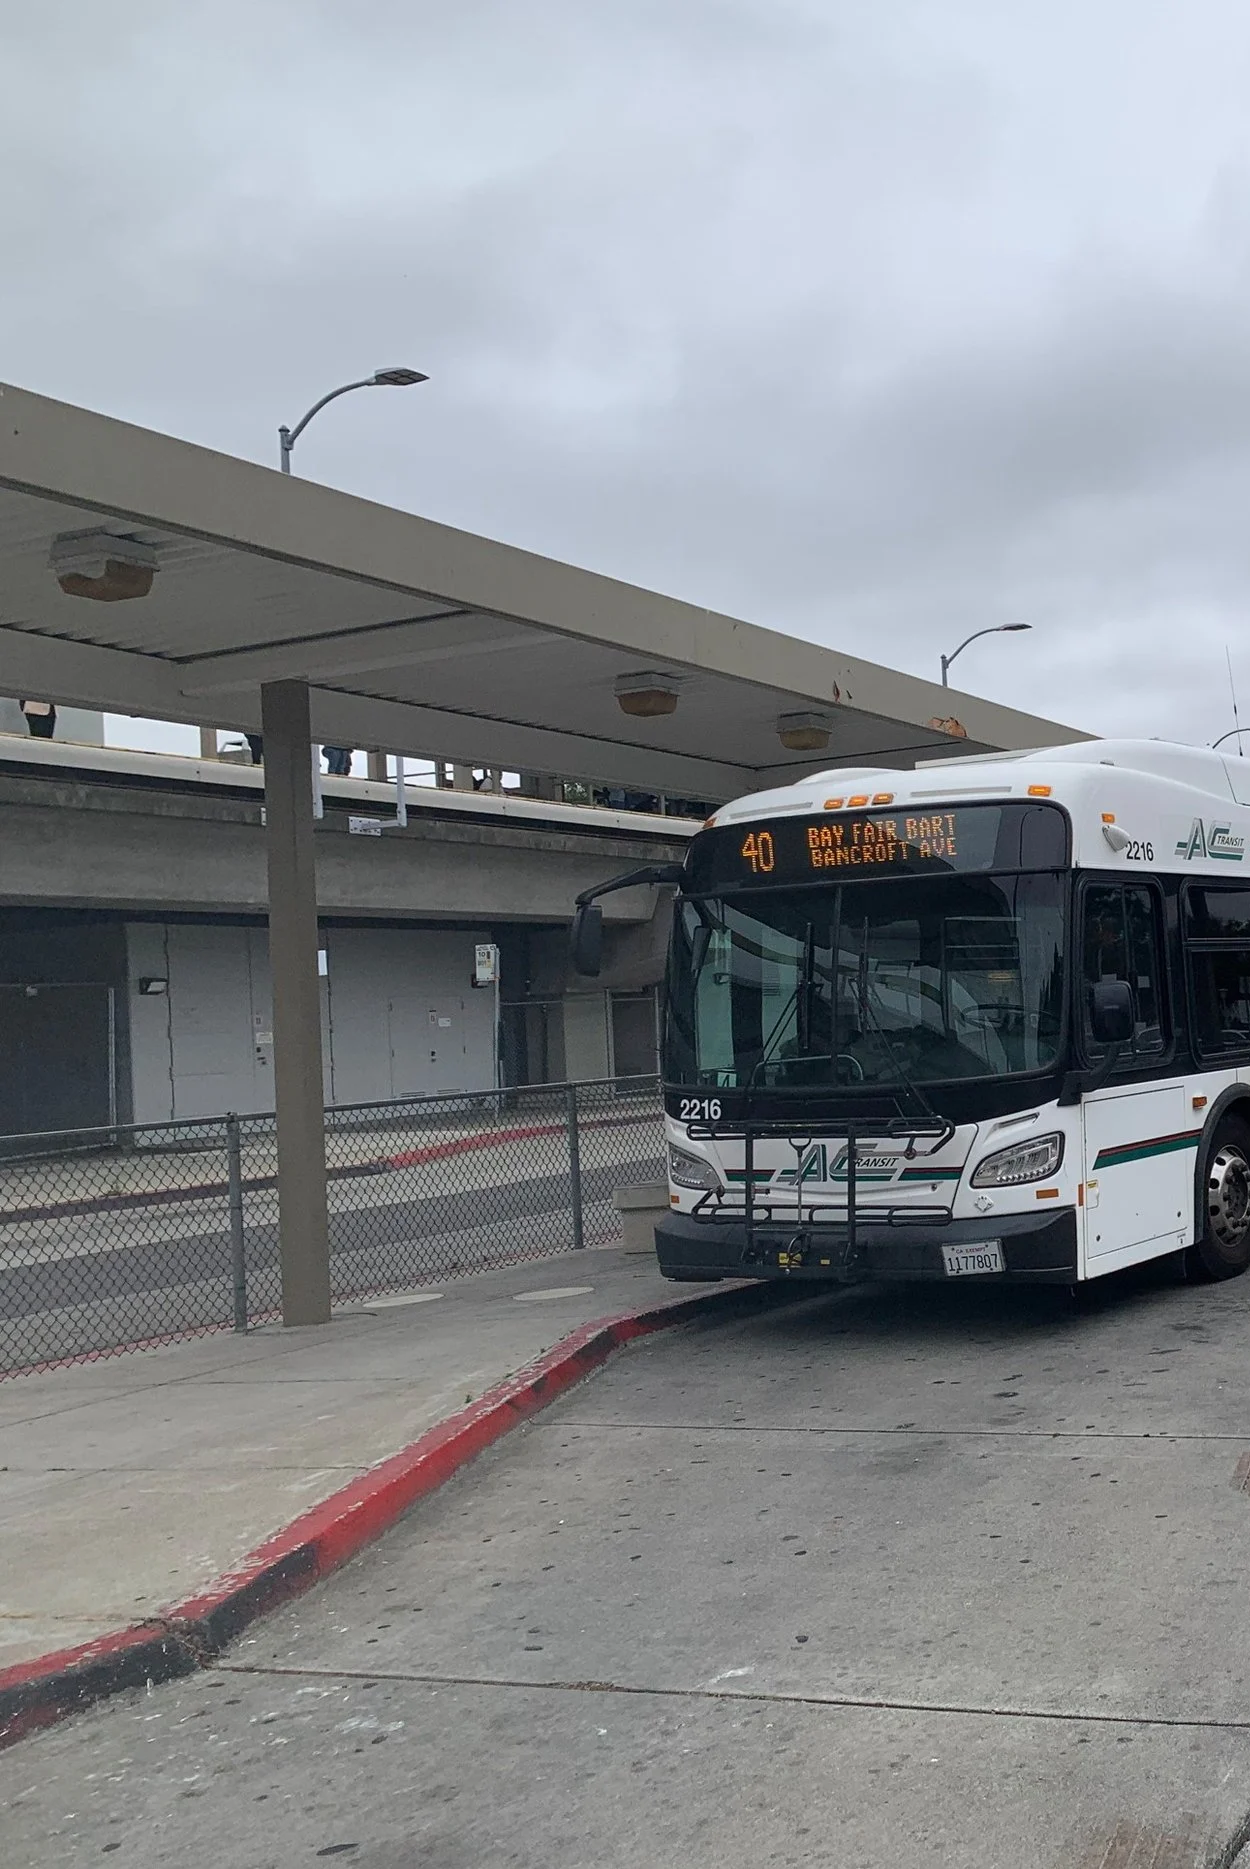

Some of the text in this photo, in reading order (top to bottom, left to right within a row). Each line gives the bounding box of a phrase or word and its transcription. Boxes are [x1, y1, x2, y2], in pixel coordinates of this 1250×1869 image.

[807, 814, 956, 849] BAY FAIR BART
[1174, 818, 1245, 861] AC TRANSIT
[742, 831, 775, 873] 40
[811, 837, 958, 868] BANCROFT AVE
[1126, 840, 1154, 862] 2216
[680, 1098, 722, 1120] 2216
[852, 1157, 900, 1168] RANSIT
[948, 1253, 998, 1272] 1177807
